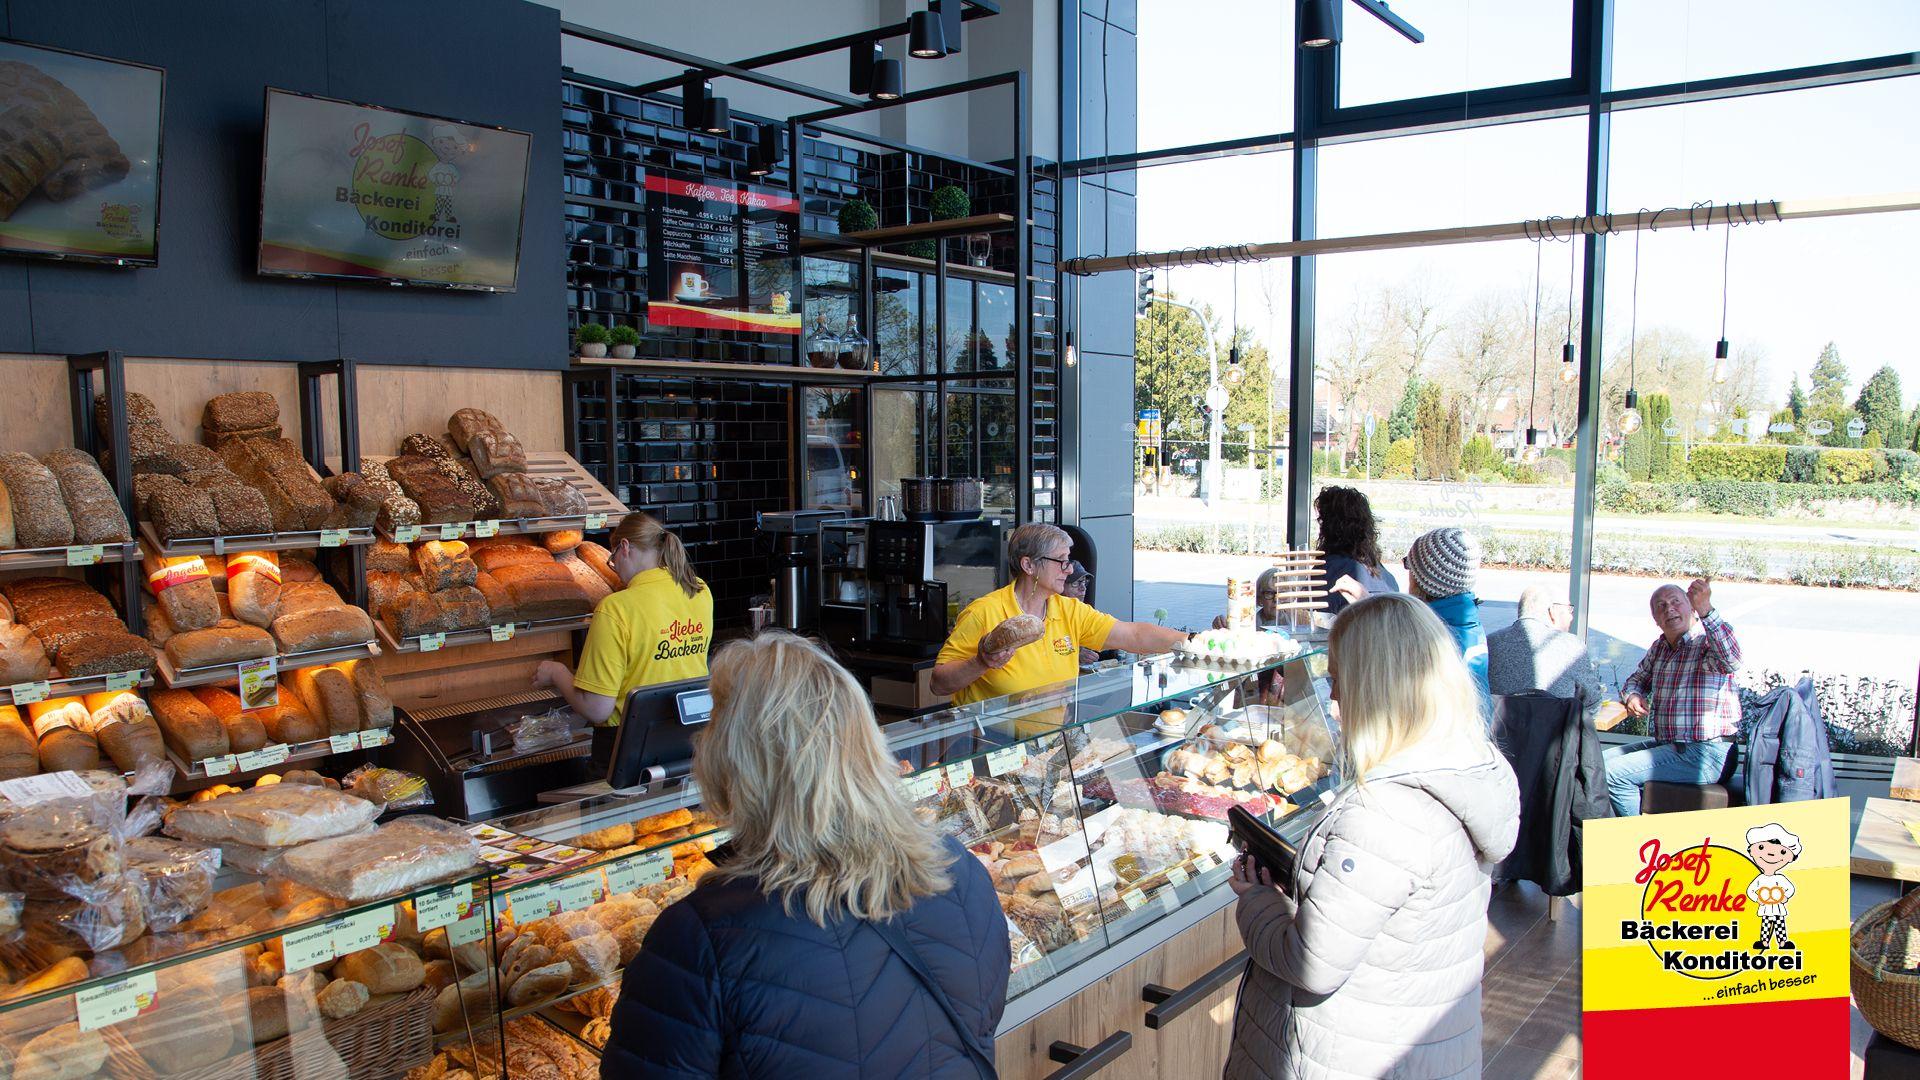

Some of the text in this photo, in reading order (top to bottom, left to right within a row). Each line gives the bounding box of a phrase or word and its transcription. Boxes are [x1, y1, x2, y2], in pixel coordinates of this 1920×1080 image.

[350, 122, 406, 165] Josef
[356, 156, 428, 189] Remke
[335, 186, 420, 211] Bäckerei
[740, 192, 767, 208] Kakao
[365, 214, 461, 239] Konditorei
[662, 228, 692, 239] Cappuccino
[421, 263, 460, 277] besser
[654, 636, 709, 661] Backen!
[419, 905, 439, 914] sortiert
